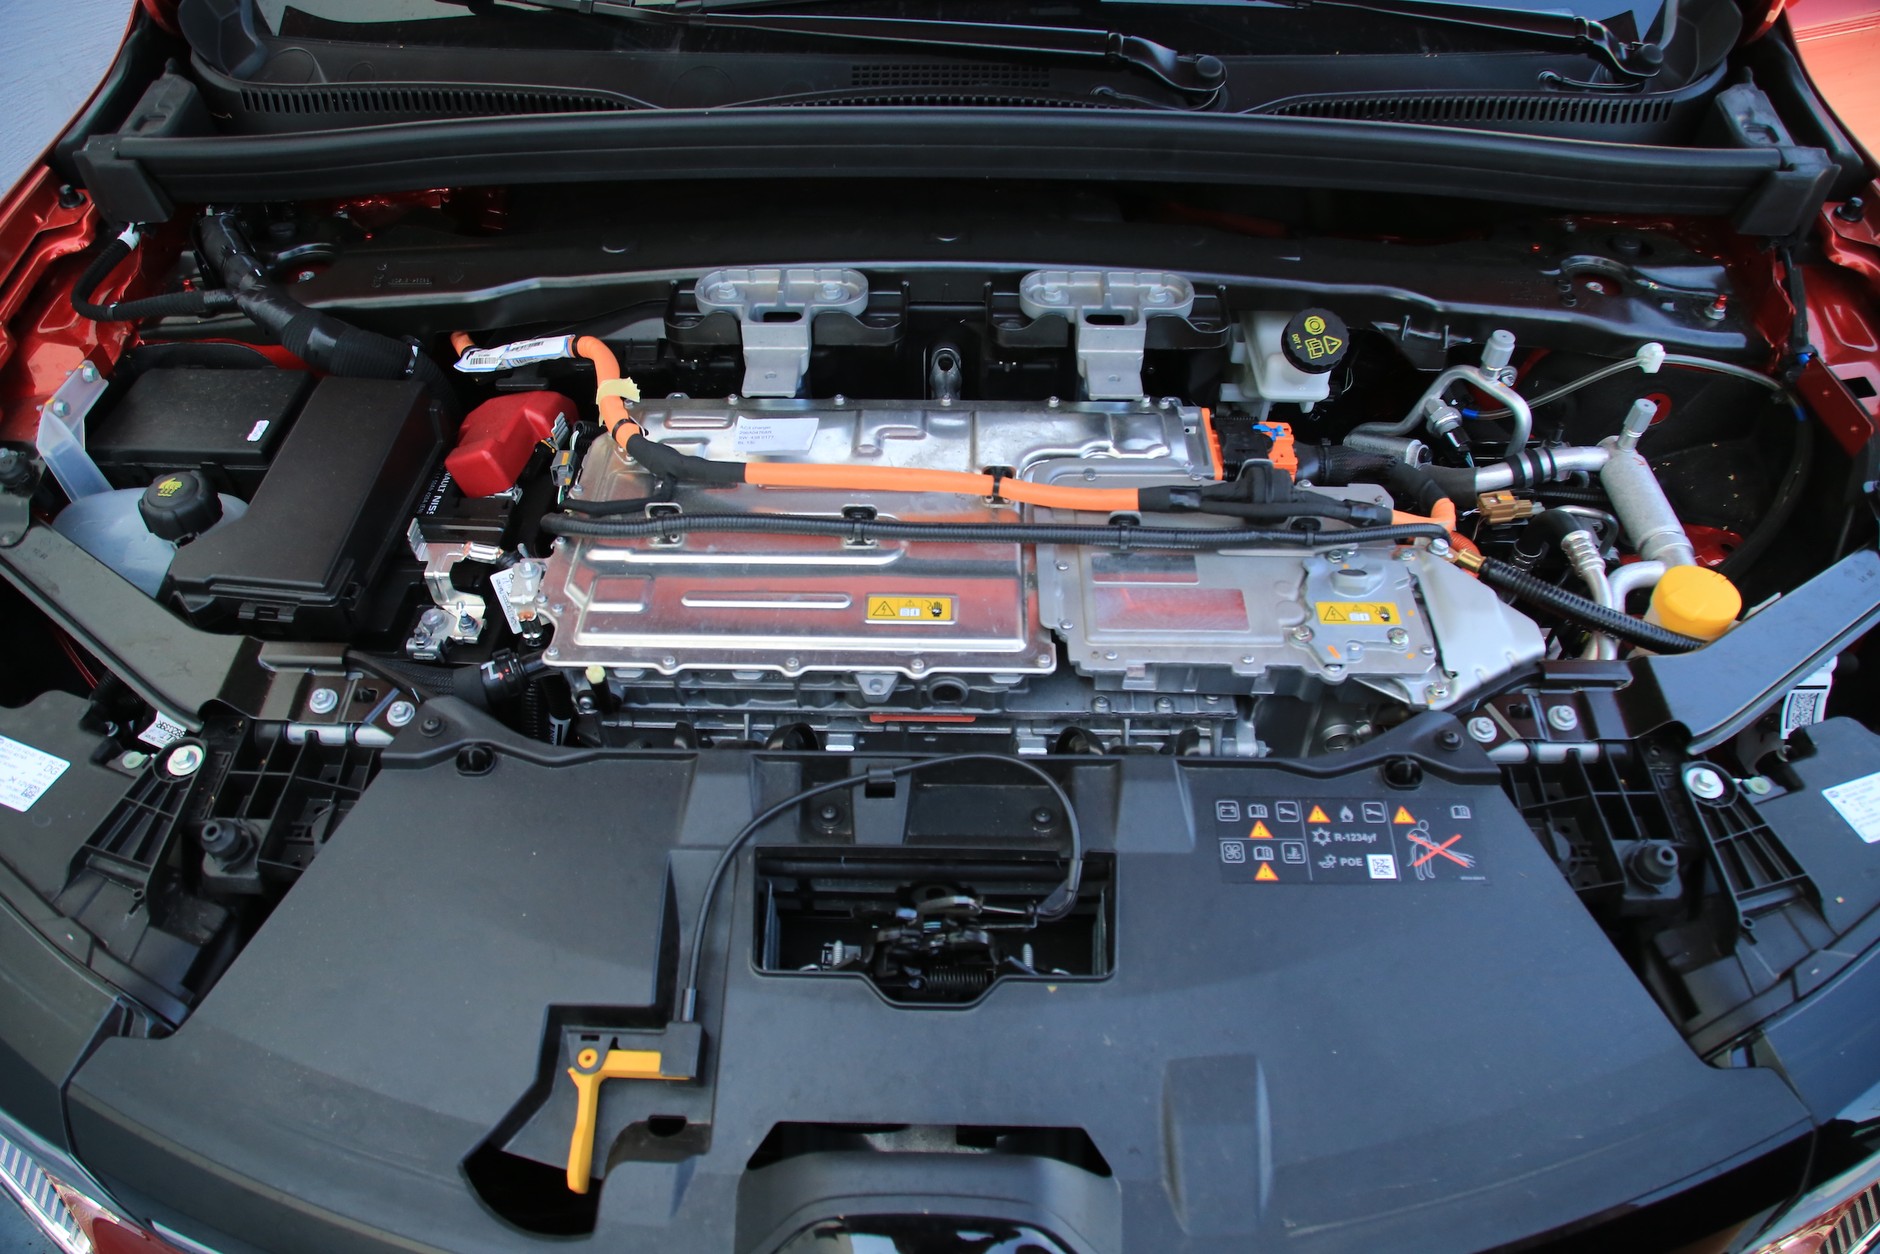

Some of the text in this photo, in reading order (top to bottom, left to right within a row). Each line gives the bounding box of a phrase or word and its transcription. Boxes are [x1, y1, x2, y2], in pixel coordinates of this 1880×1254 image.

[1292, 333, 1301, 344] DOT
[1334, 833, 1376, 843] R-1234yf
[1340, 858, 1363, 866] POE
